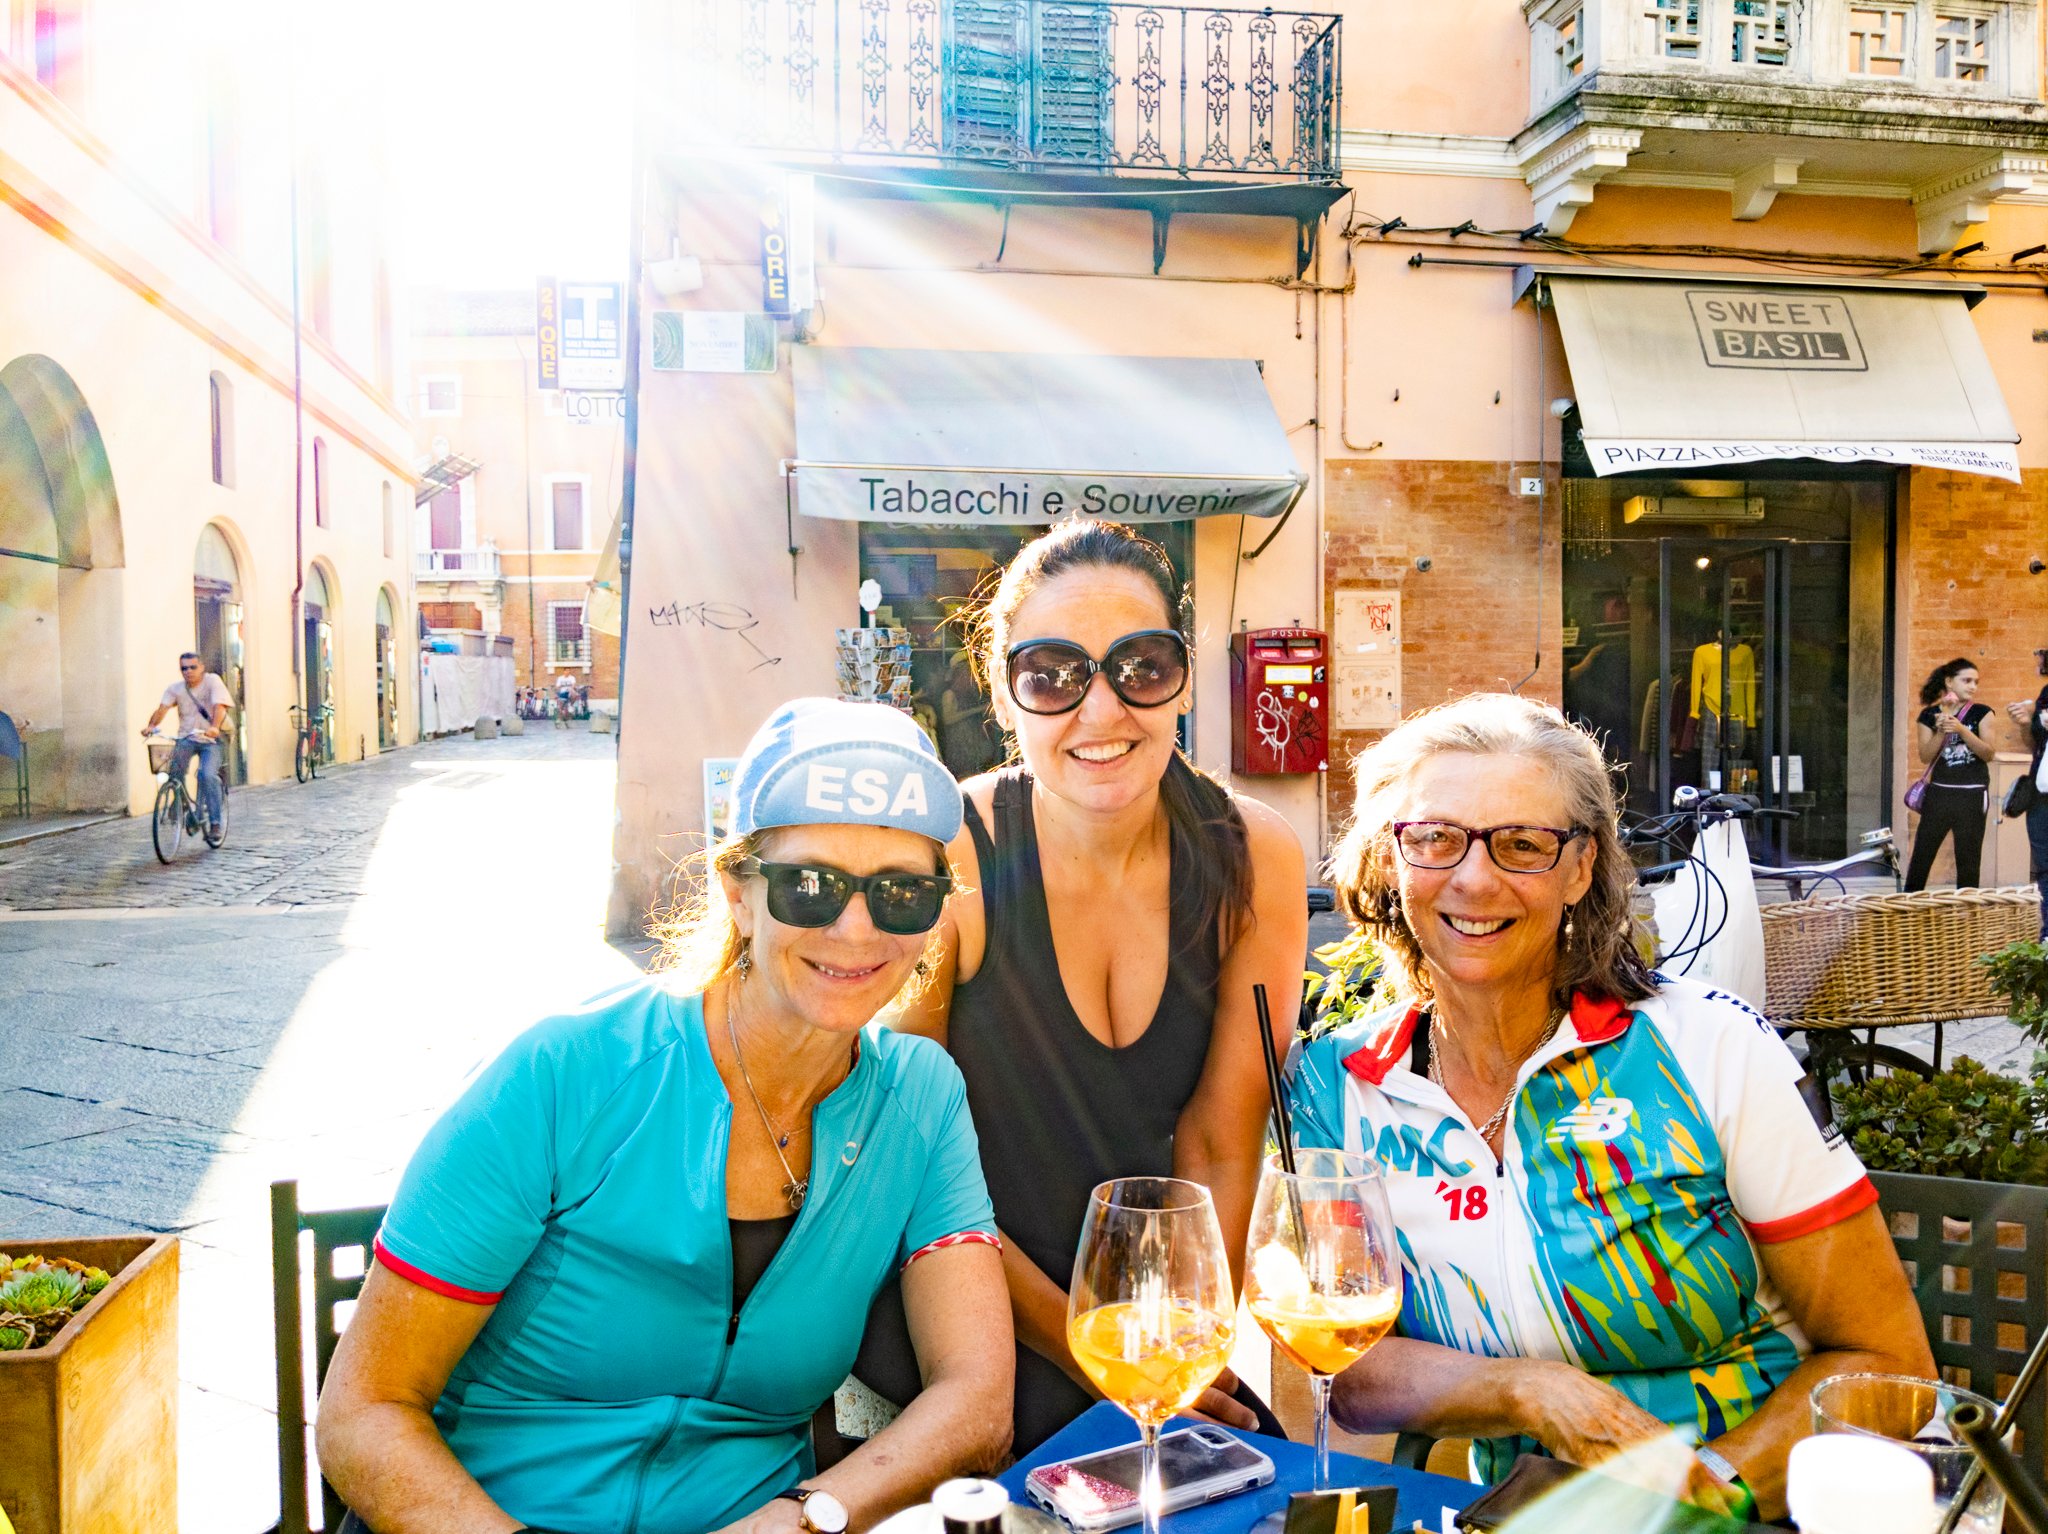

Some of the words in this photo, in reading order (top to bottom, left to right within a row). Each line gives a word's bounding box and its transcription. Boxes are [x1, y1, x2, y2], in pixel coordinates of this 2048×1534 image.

[1705, 300, 1833, 326] SWEET
[540, 325, 557, 378] ORE
[1722, 332, 1841, 359] BASIL
[1604, 446, 1711, 464] PIAZZA
[1712, 445, 1767, 459] DEL
[1774, 444, 1894, 458] POPOLO
[859, 478, 1029, 515] Tabacchi
[1042, 490, 1063, 514] e
[1271, 629, 1308, 638] POSTE
[805, 763, 928, 816] ESA
